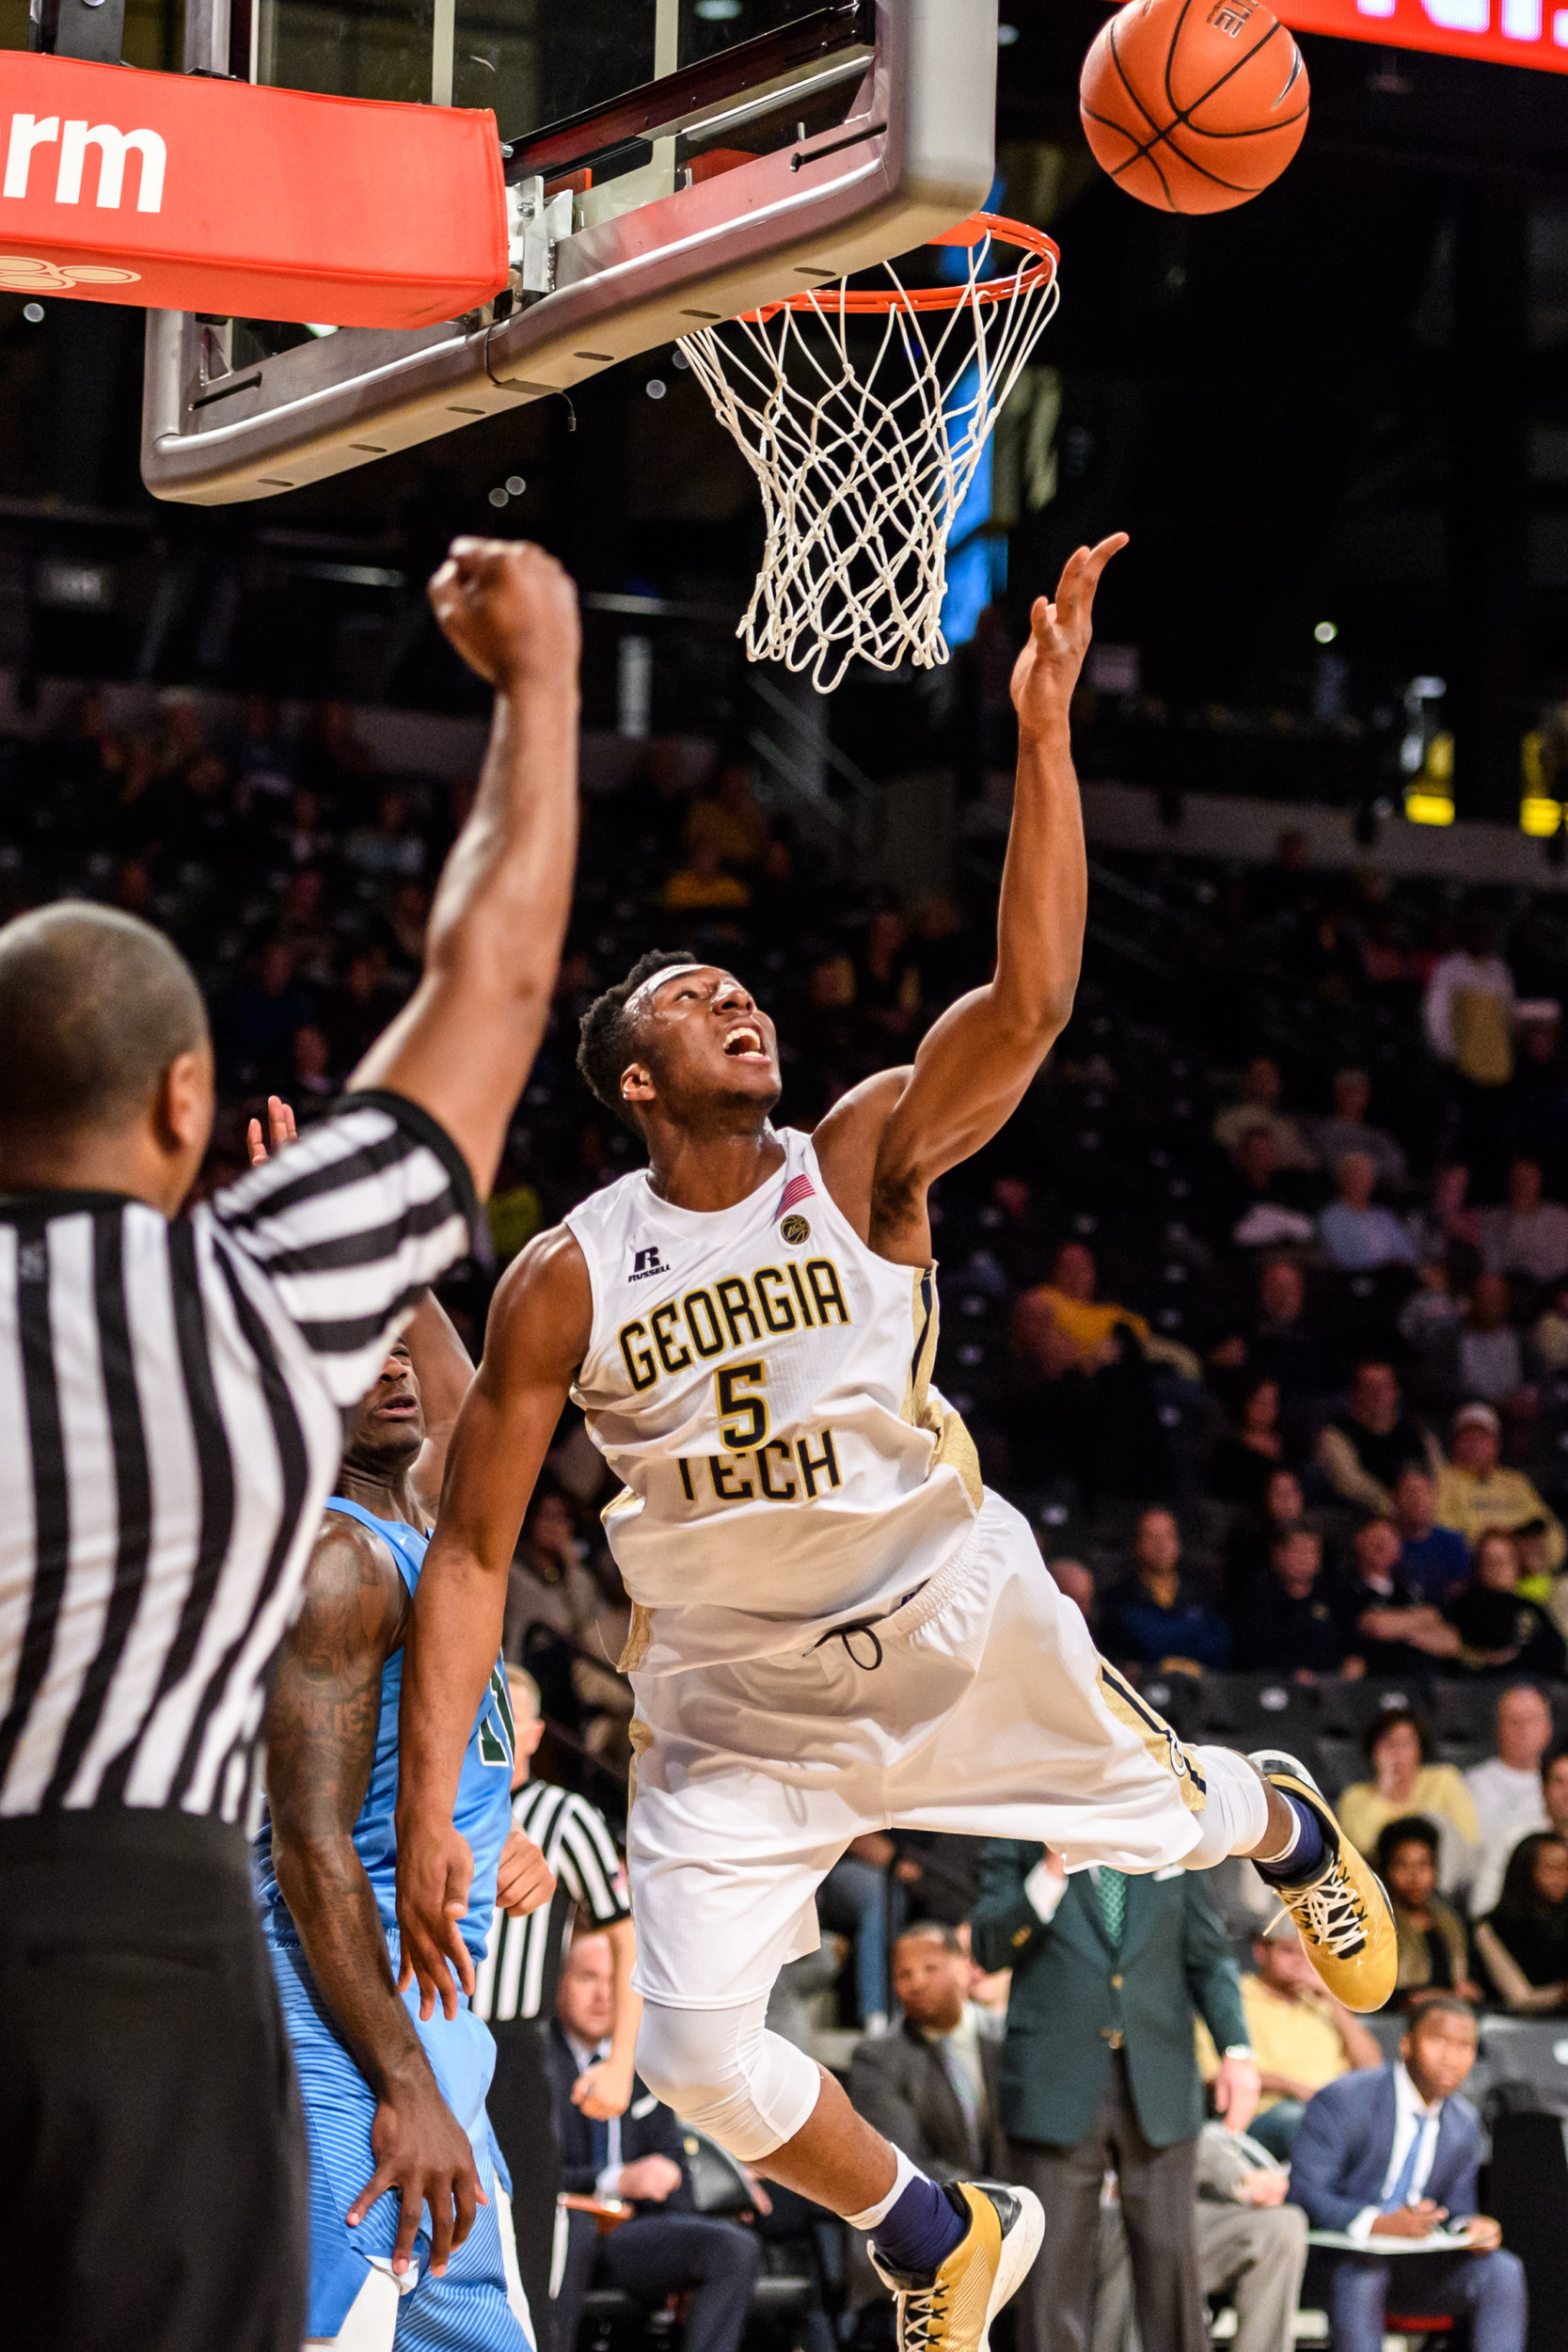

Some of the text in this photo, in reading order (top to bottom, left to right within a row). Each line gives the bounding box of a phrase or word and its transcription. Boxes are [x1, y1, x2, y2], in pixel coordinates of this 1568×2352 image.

[627, 1263, 672, 1283] RUSSELL
[634, 1246, 660, 1273] R
[617, 1257, 851, 1393] GEORGIA
[714, 1359, 771, 1453] 5
